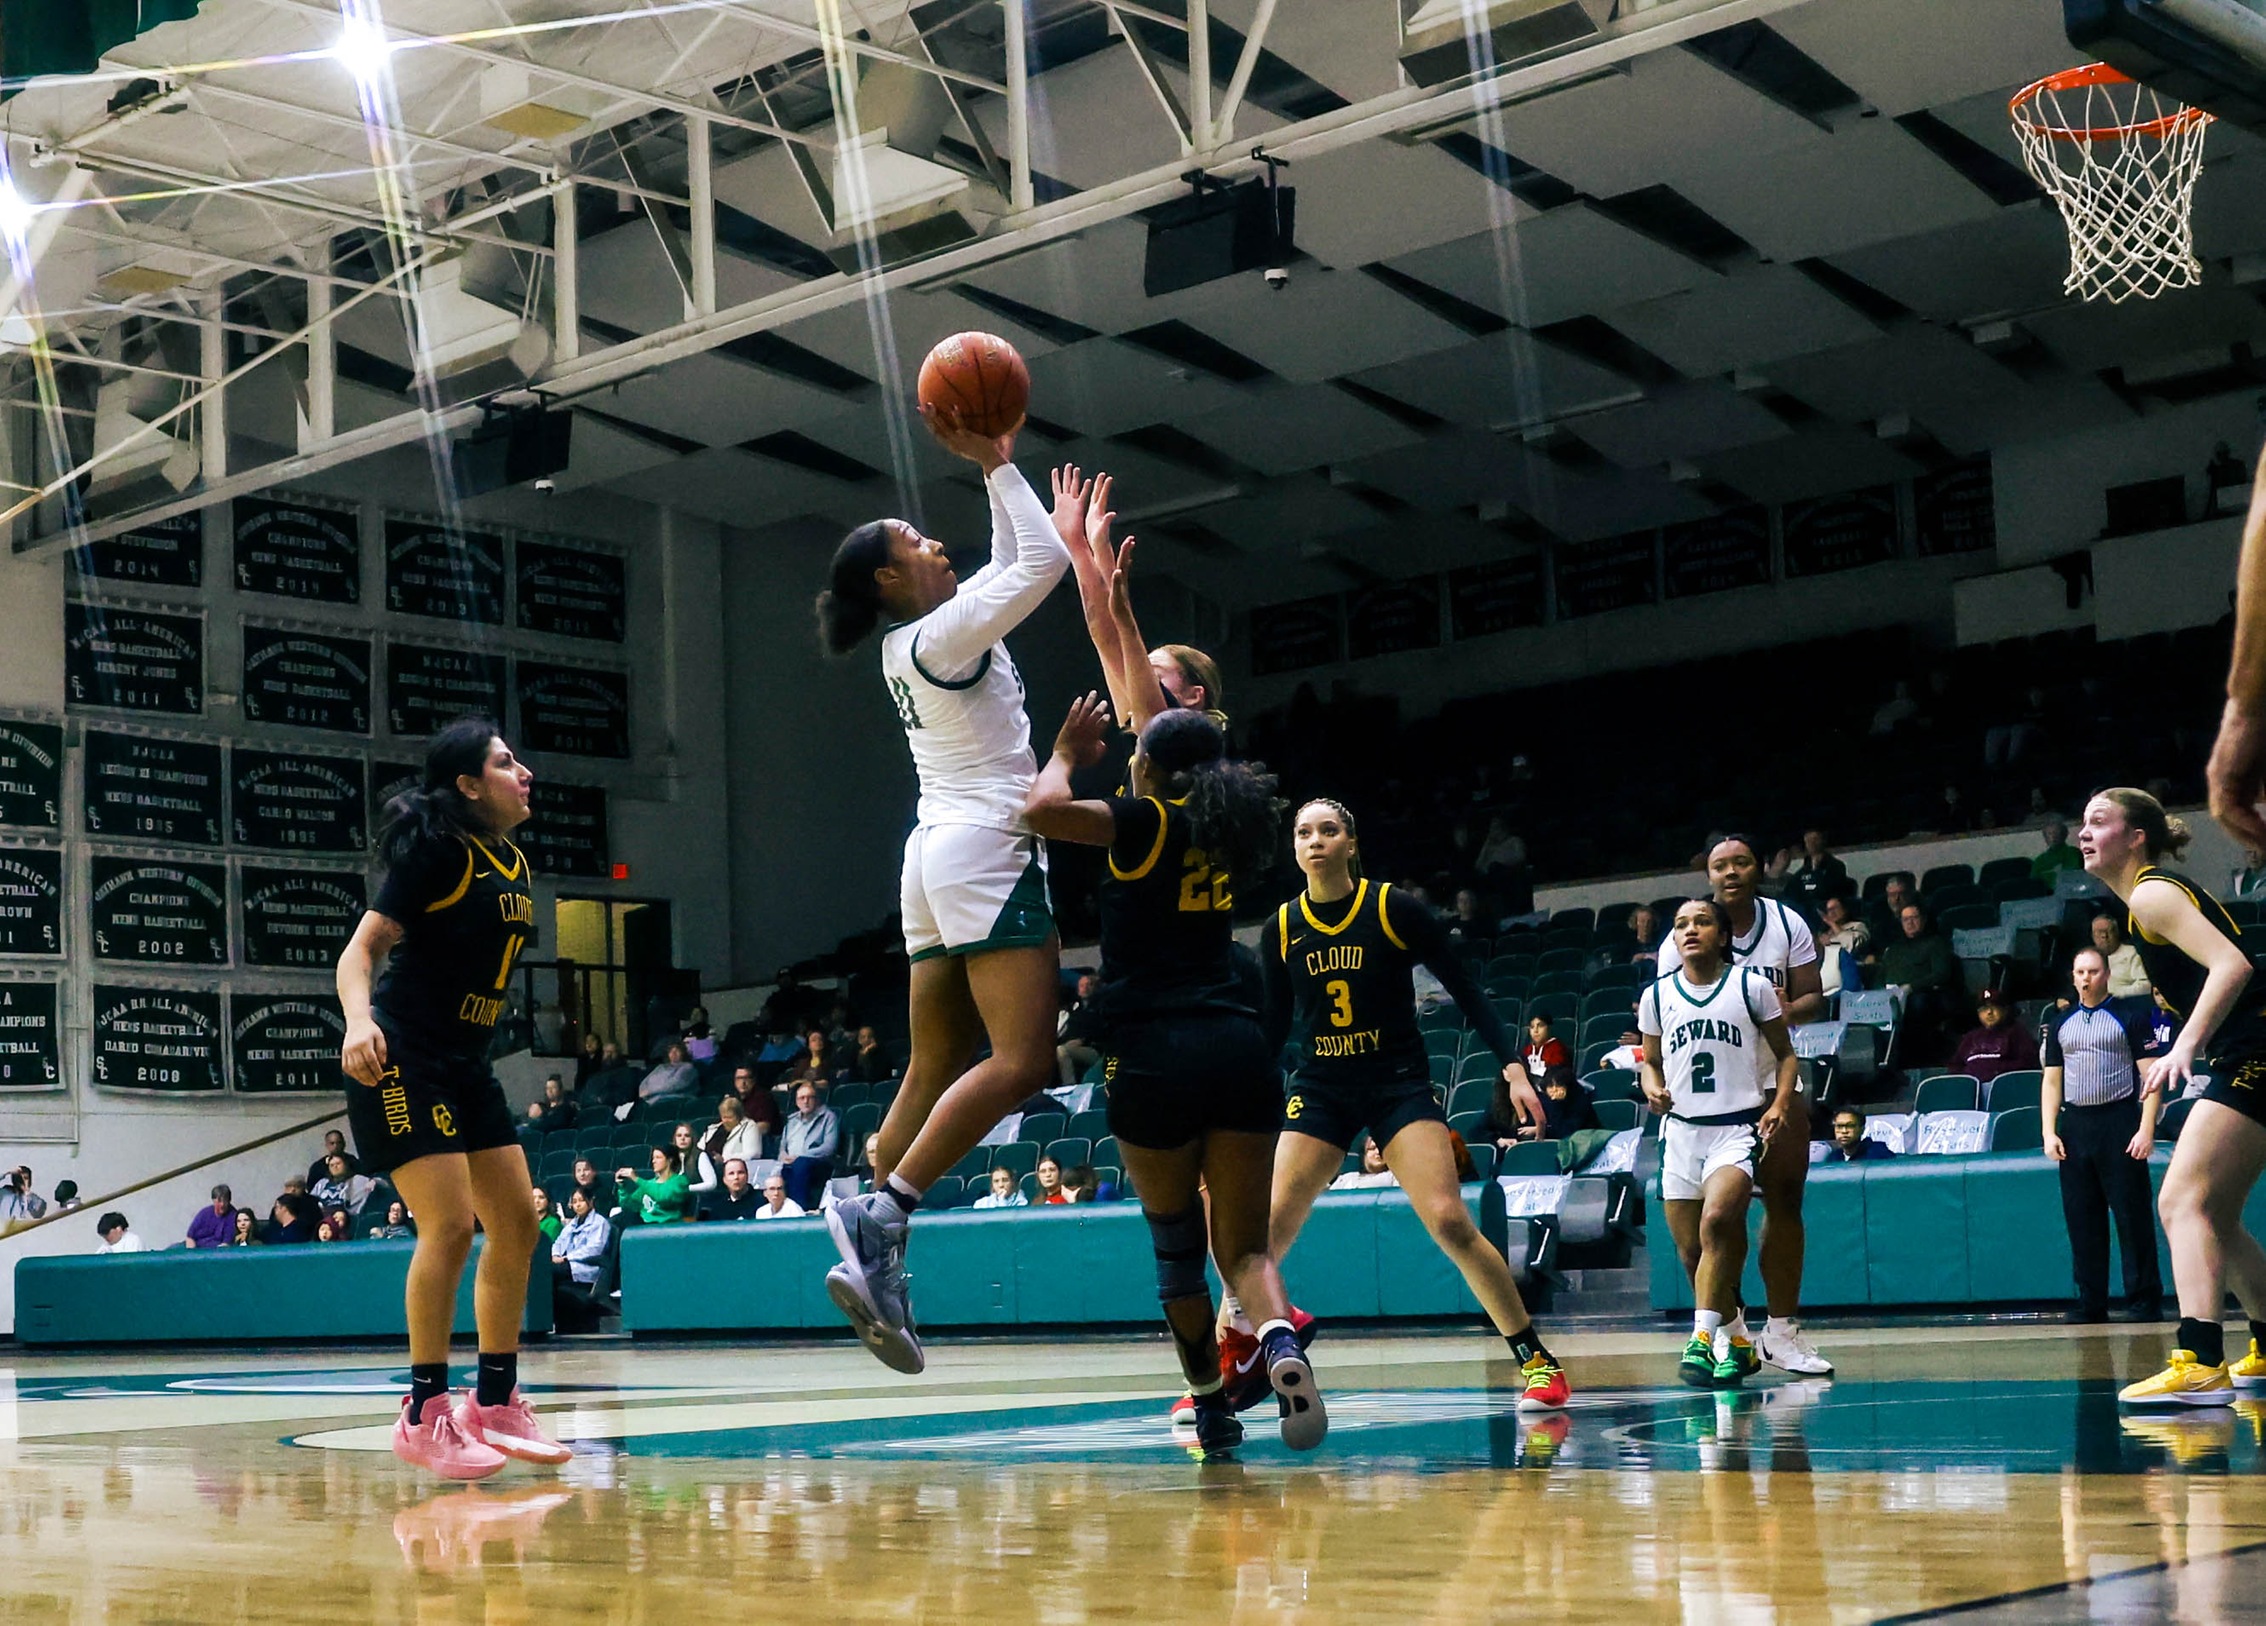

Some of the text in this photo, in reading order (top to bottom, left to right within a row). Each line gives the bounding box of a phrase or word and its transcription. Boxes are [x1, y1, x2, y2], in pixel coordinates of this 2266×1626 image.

[128, 892, 191, 907] CHAMPIONS
[143, 915, 208, 931] BASKETBALL
[137, 939, 185, 957] 2002
[1305, 945, 1364, 977] CLOUD
[1325, 978, 1354, 1028] 3
[142, 1022, 205, 1038] BASKETBALL
[1669, 1018, 1743, 1054] SEWARD
[1314, 1028, 1381, 1057] COUNTY
[136, 1066, 182, 1084] 2008
[1691, 1052, 1716, 1093] 2
